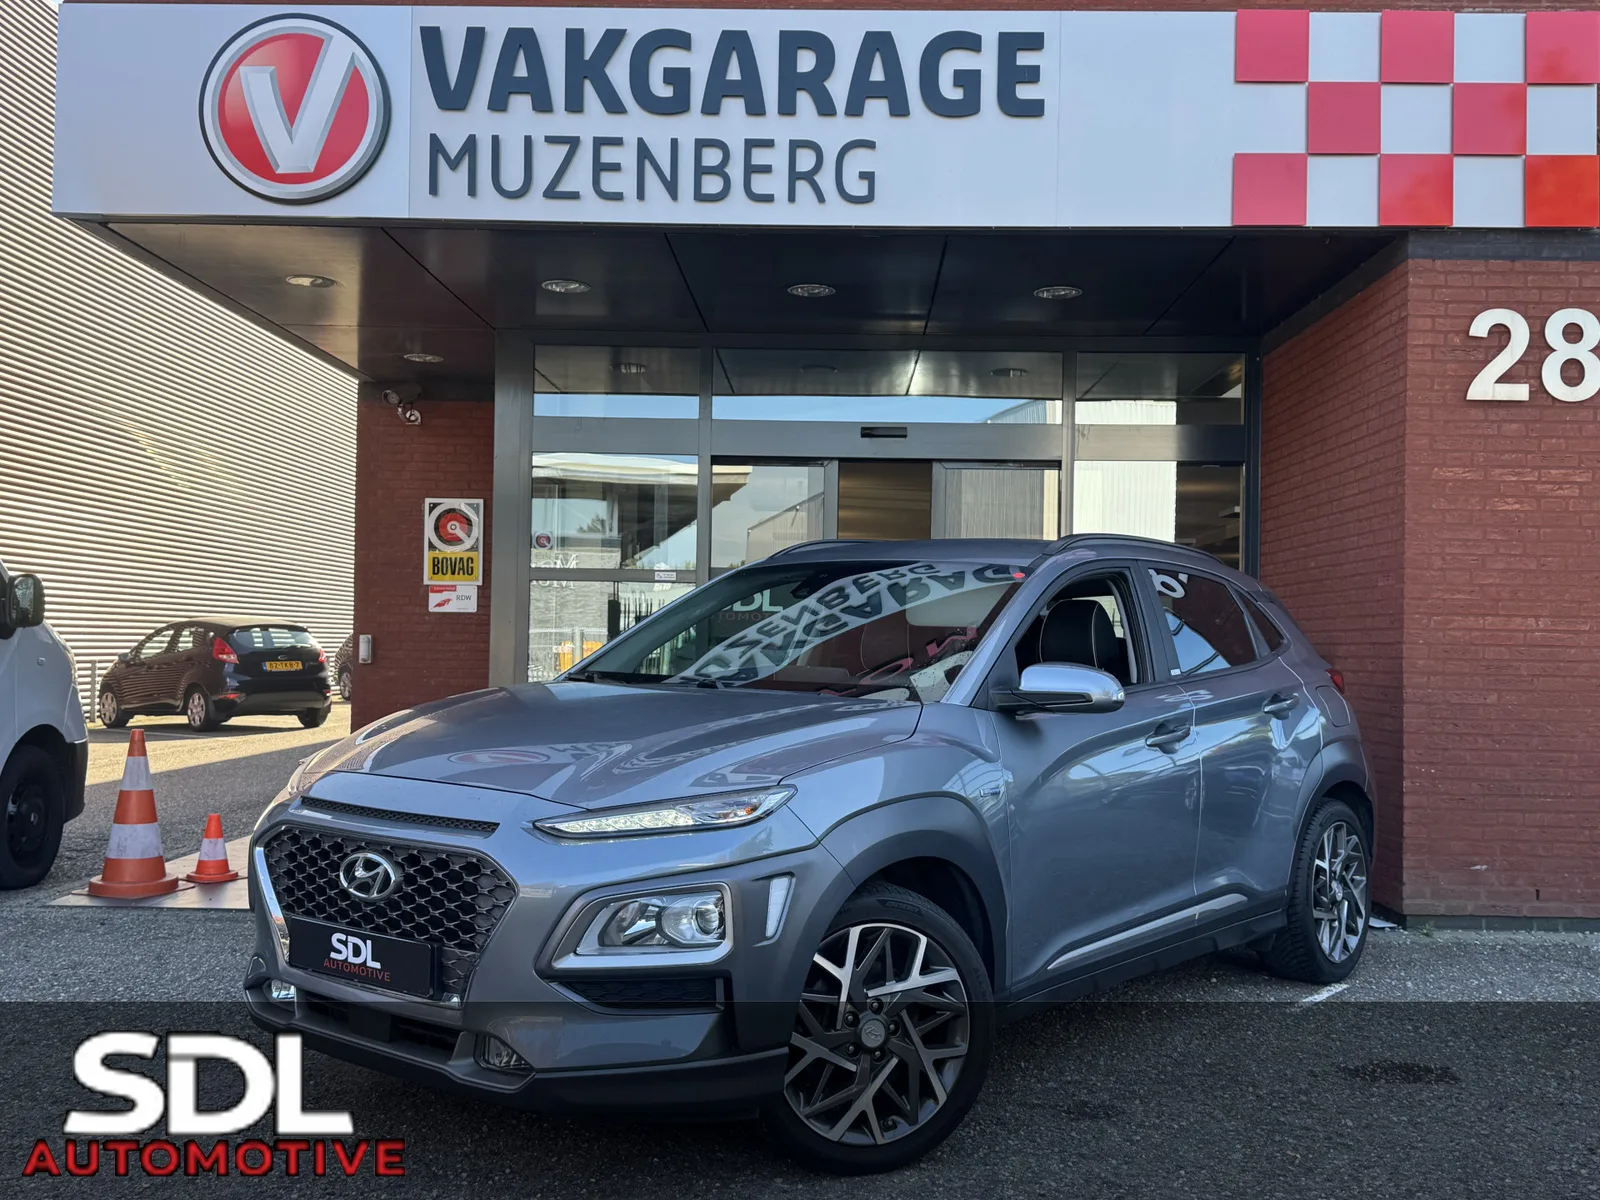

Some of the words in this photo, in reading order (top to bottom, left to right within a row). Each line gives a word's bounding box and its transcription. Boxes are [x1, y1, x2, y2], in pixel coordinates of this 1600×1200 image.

[420, 26, 1044, 118] VAKGARAGE
[429, 133, 876, 204] MUZENBERG
[1466, 308, 1600, 402] 28
[432, 556, 474, 577] BOVAG
[324, 958, 390, 982] AUTOMOTIVE
[330, 932, 382, 969] SDL
